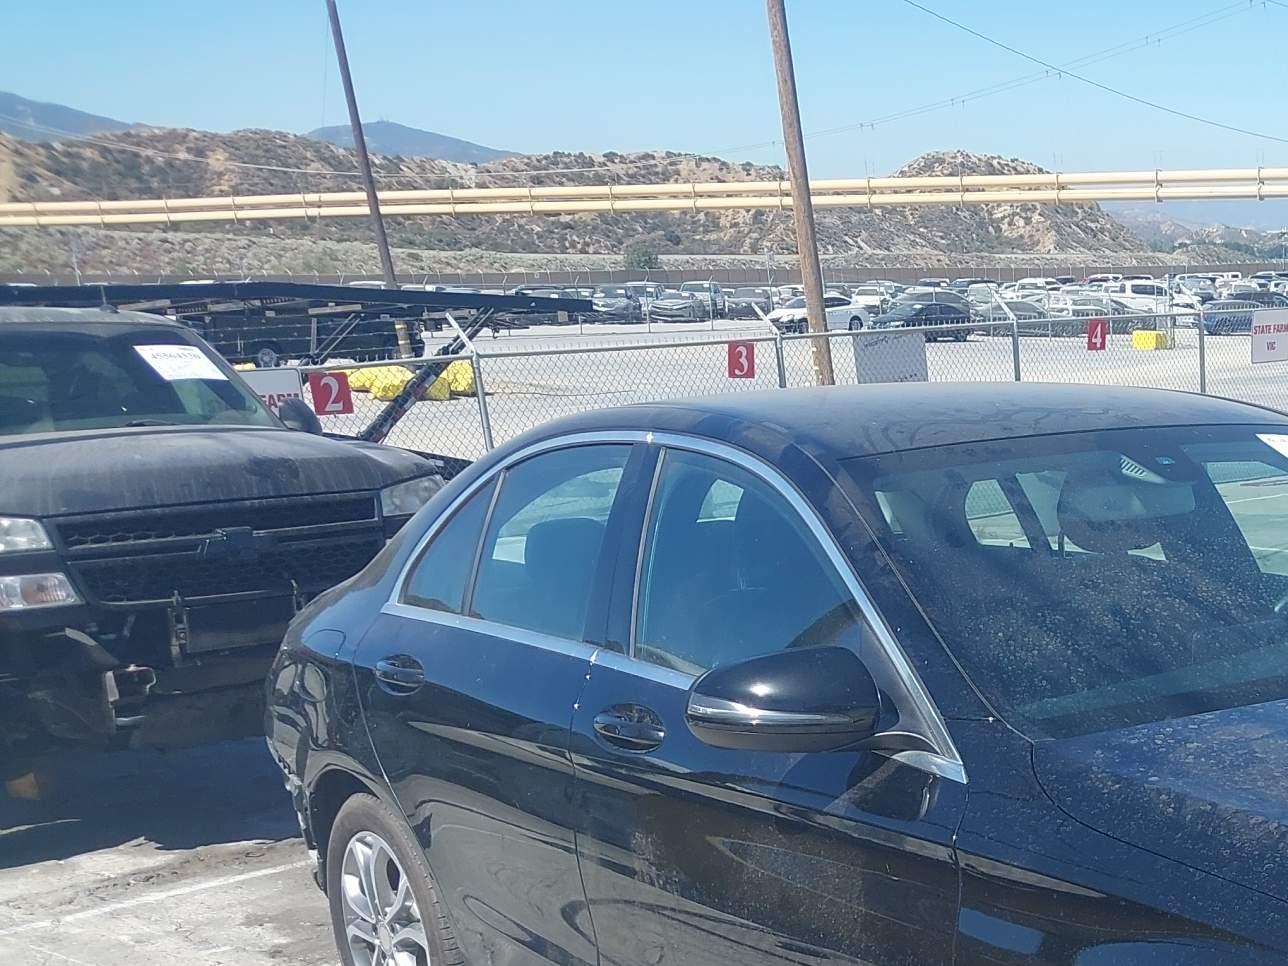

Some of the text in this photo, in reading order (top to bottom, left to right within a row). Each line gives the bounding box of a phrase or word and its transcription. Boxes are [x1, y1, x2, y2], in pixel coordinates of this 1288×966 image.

[1092, 324, 1103, 347] 4
[1254, 324, 1288, 334] STATE FARM
[734, 346, 748, 376] 3
[320, 376, 343, 411] 2
